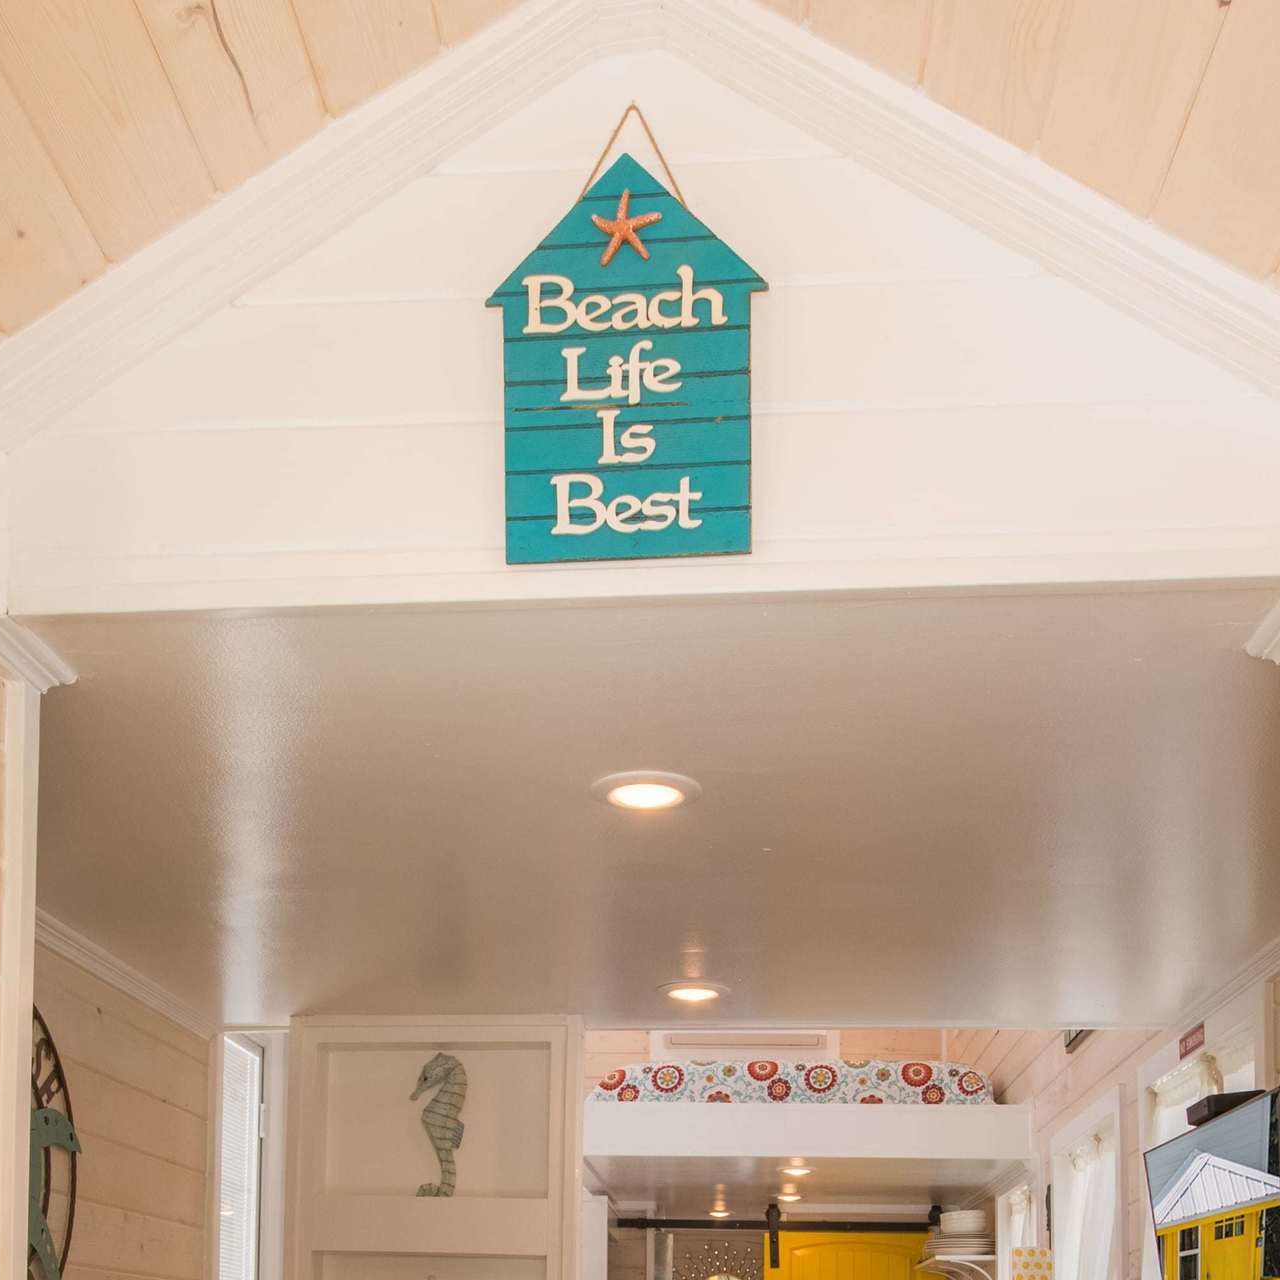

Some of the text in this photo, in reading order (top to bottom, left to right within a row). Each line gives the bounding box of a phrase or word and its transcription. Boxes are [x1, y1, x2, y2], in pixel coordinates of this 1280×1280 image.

[521, 265, 727, 333] Beach
[560, 340, 681, 404] Life
[597, 409, 656, 464] Is
[550, 473, 702, 534] Best
